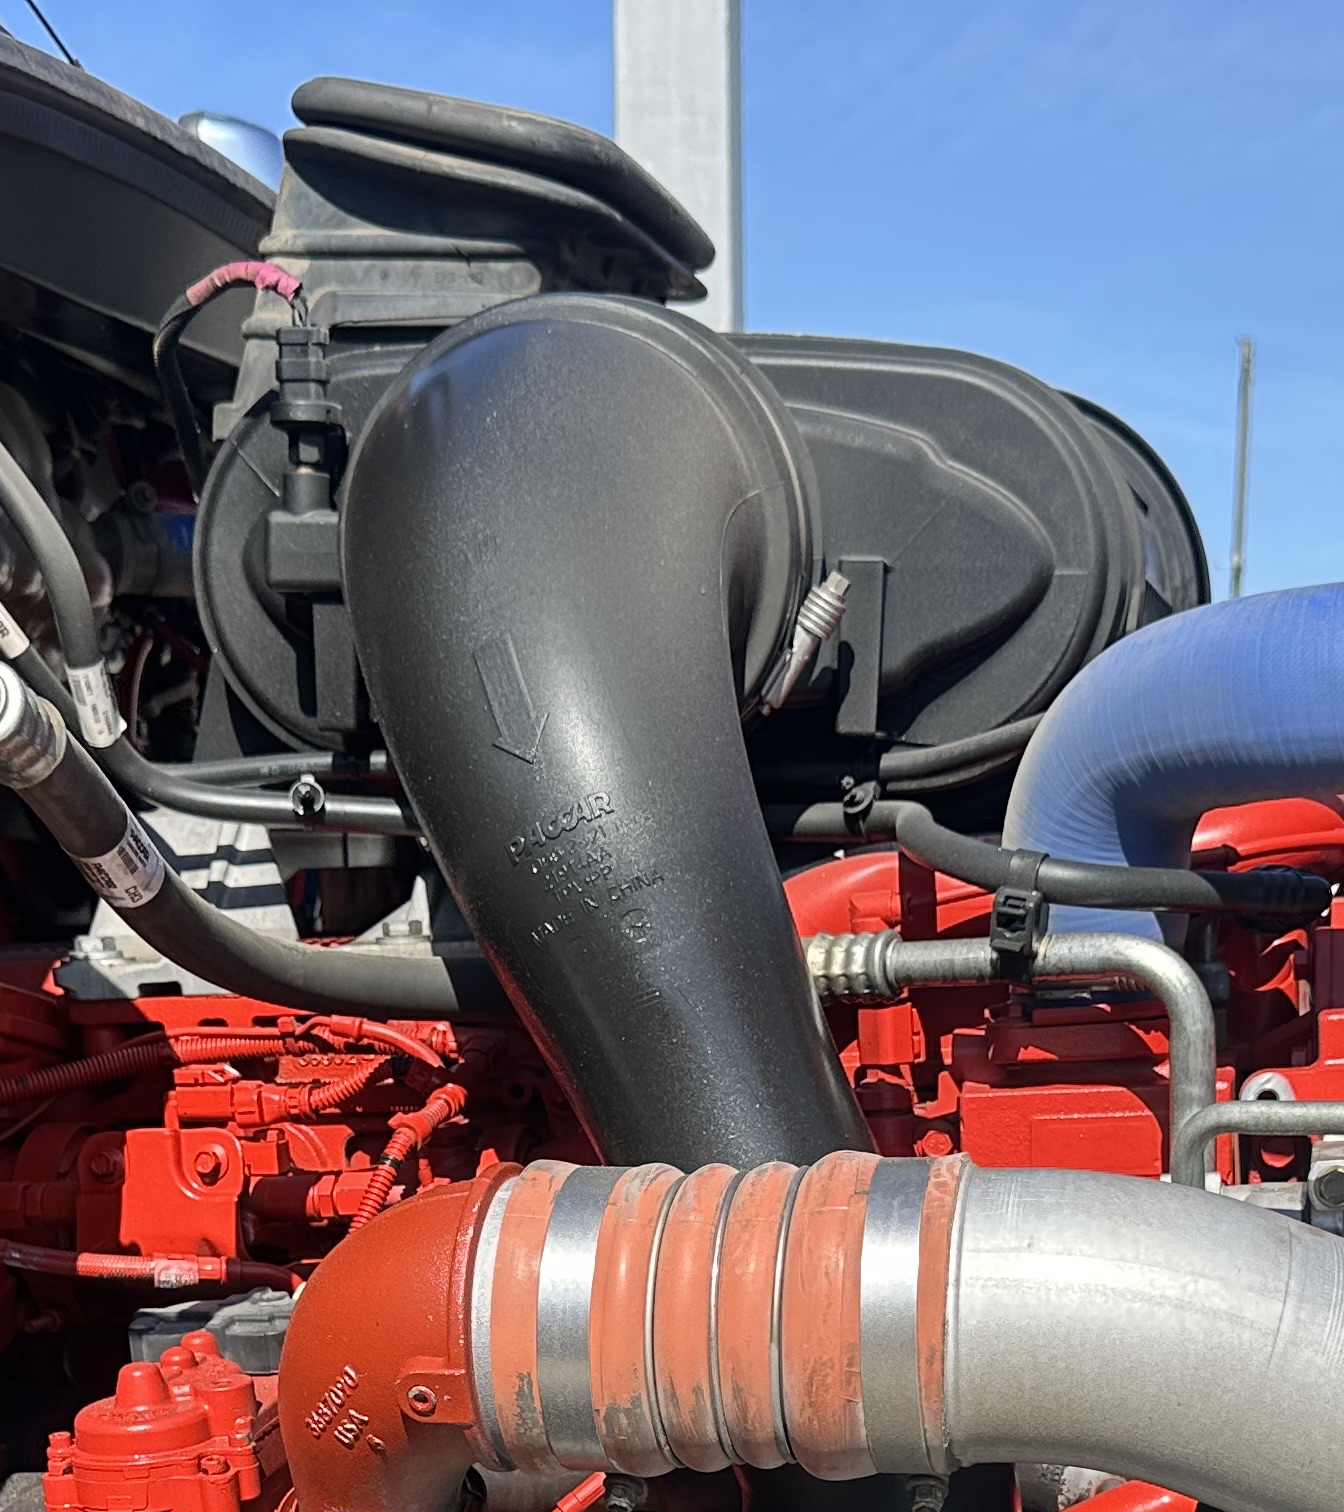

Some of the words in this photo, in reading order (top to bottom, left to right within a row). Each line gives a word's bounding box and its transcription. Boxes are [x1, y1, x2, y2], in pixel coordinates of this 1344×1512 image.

[507, 791, 615, 867] PACCAR
[609, 873, 665, 900] CHINA
[333, 1408, 369, 1451] USA
